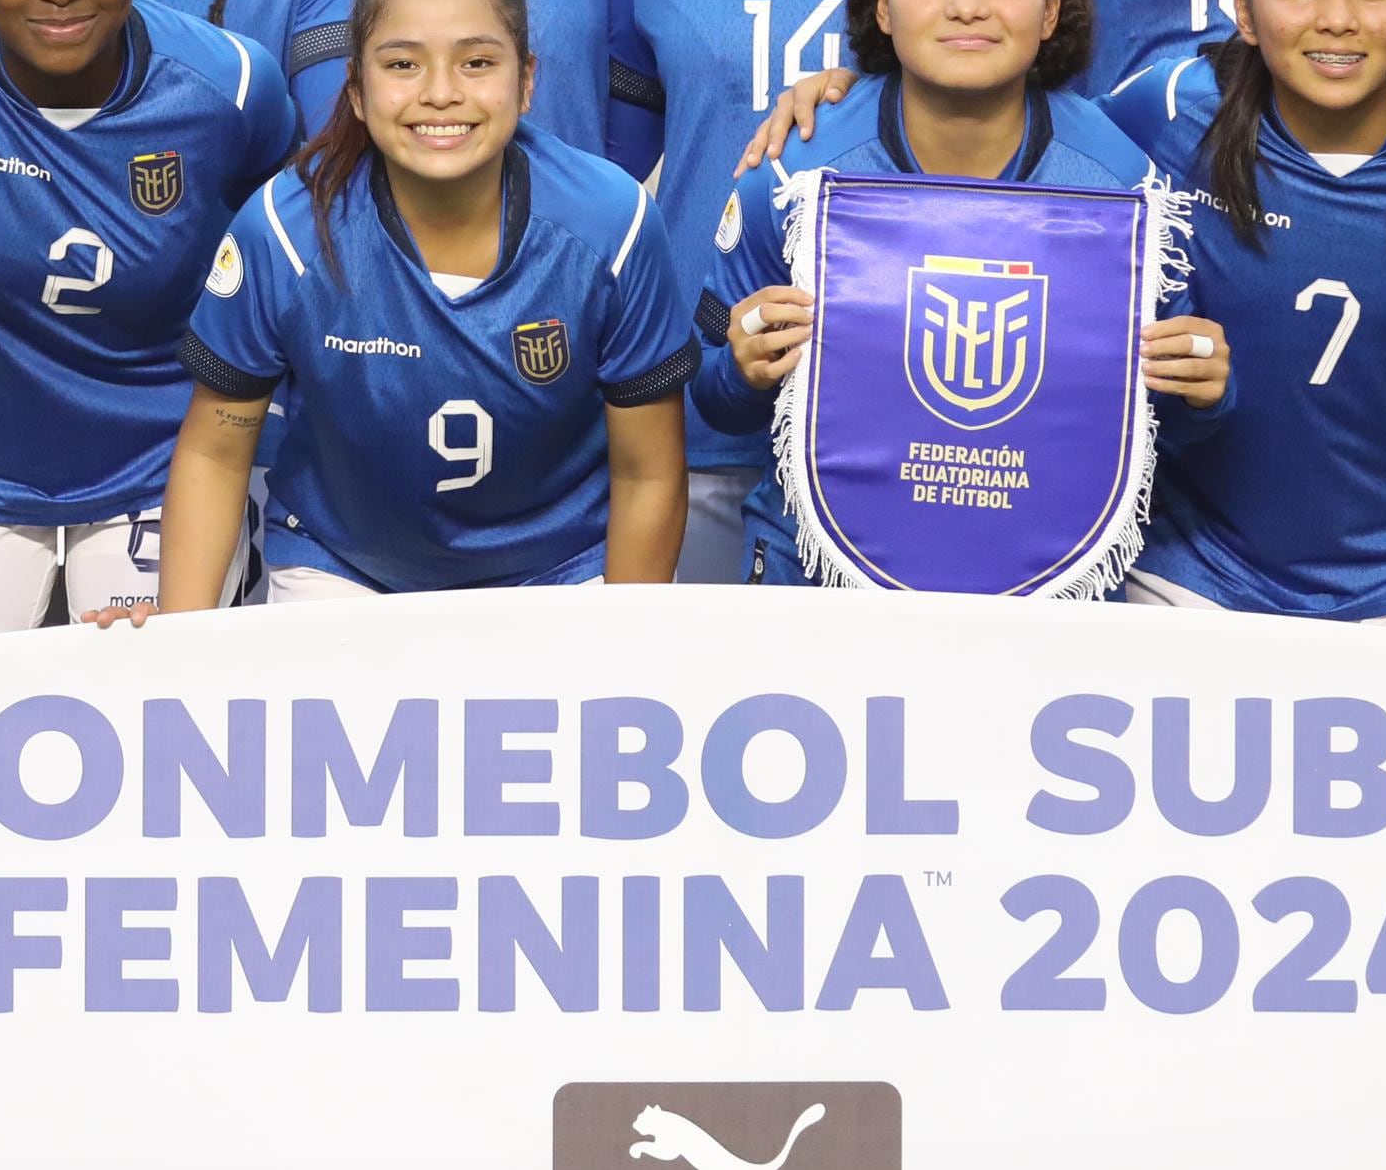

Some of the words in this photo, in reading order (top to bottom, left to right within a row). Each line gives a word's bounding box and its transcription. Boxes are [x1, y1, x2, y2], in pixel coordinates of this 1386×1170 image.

[41, 227, 114, 314] 2
[1295, 278, 1361, 385] 7
[324, 335, 421, 359] marathon
[428, 399, 493, 492] 9
[909, 442, 1025, 468] FEDERACIÓN
[900, 462, 1030, 489] ECUATORIANA
[913, 484, 938, 503] DE
[941, 482, 1013, 510] FÚTBOL
